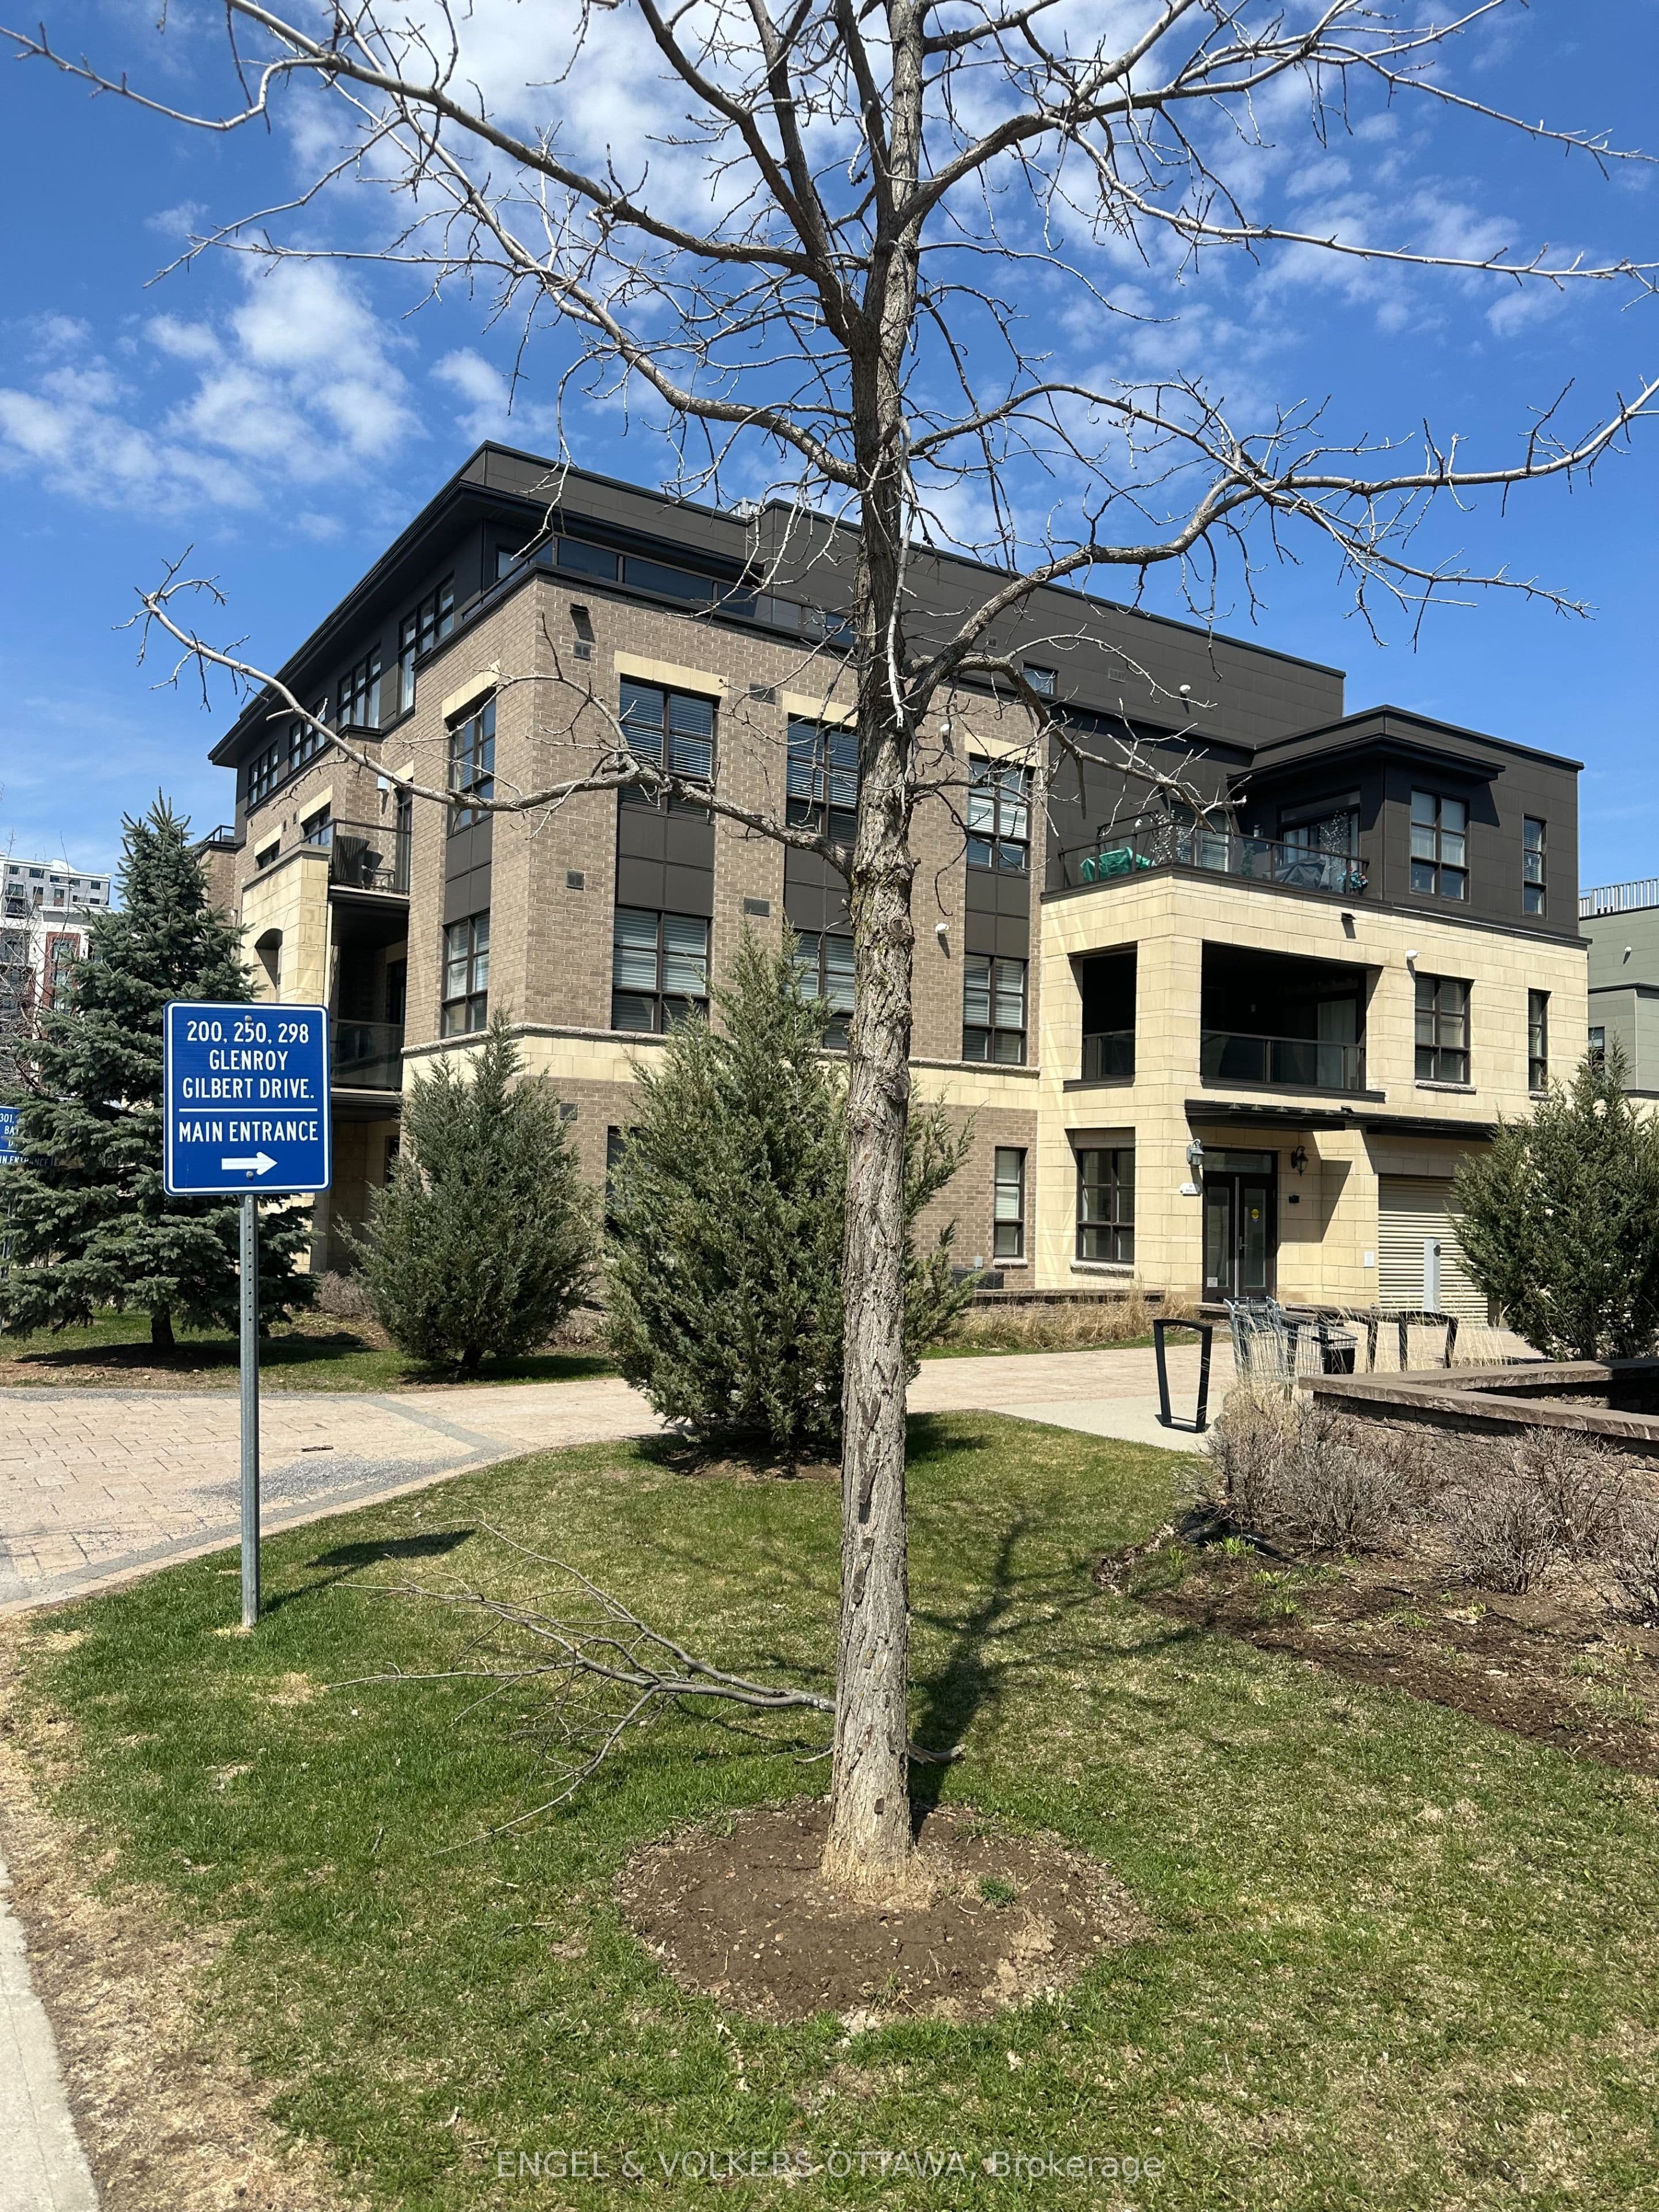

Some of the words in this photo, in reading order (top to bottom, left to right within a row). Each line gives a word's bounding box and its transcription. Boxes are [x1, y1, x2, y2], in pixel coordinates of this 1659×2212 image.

[187, 1020, 228, 1044] 200,
[233, 1021, 272, 1044] 250,
[278, 1022, 309, 1044] 298
[209, 1049, 289, 1071] GLENROY
[183, 1077, 253, 1099] GILBERT
[260, 1078, 315, 1099] DRIVE.
[179, 1121, 223, 1142] MAIN
[229, 1120, 319, 1142] ENTRANCE
